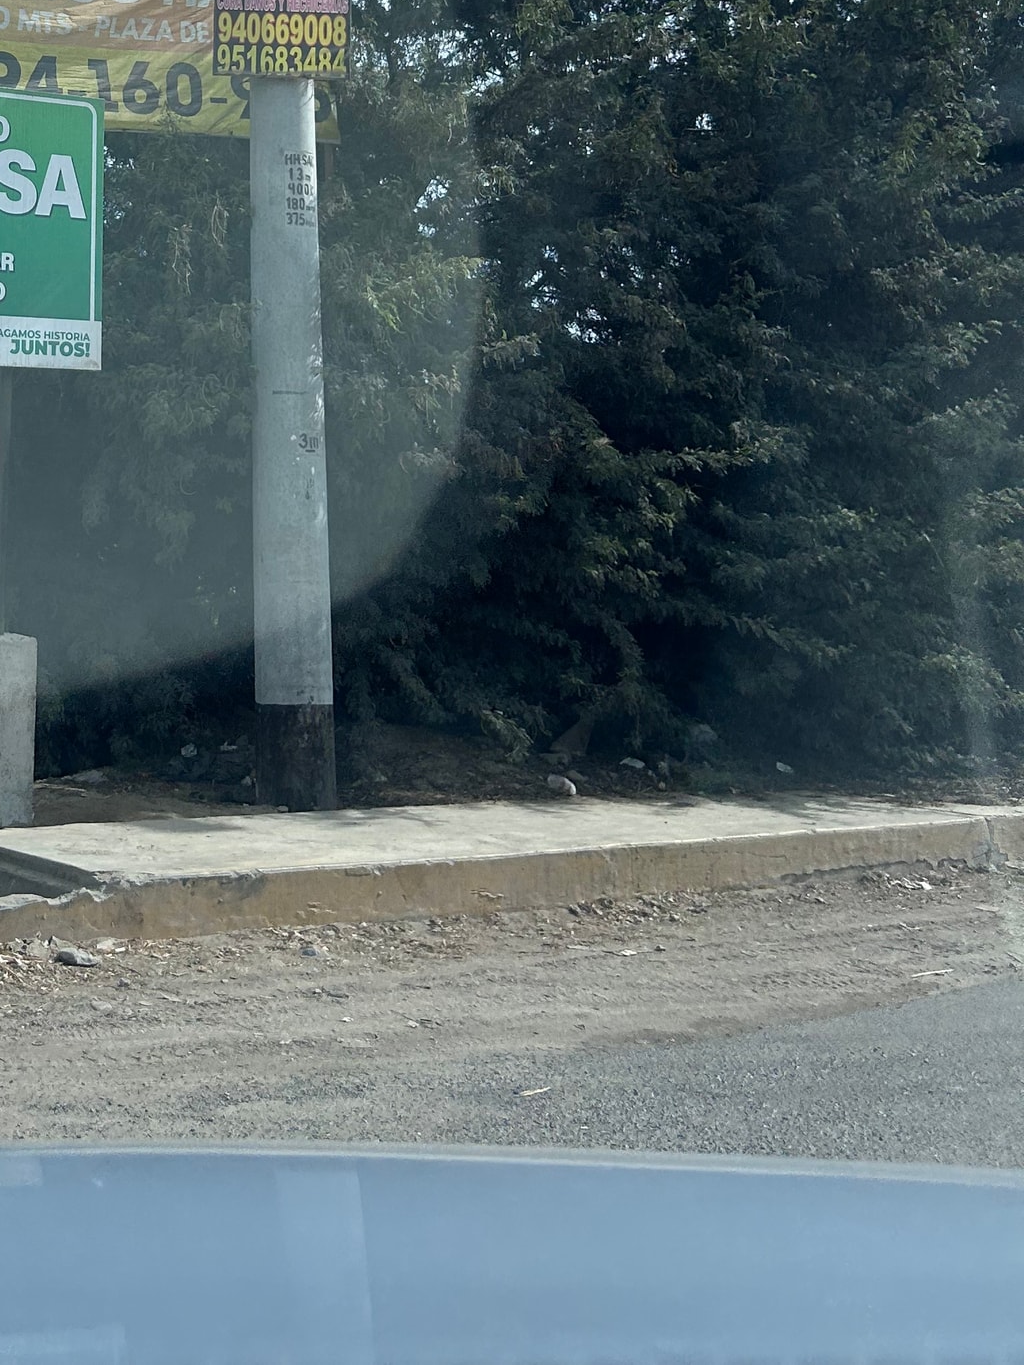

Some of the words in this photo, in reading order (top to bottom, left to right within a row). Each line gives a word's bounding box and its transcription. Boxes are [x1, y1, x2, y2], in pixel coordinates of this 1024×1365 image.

[95, 14, 174, 43] PLAZA
[218, 12, 347, 47] 940669008
[217, 44, 347, 75] 951683484
[10, 339, 90, 357] JUNTOS!
[43, 330, 90, 342] HISTORIA
